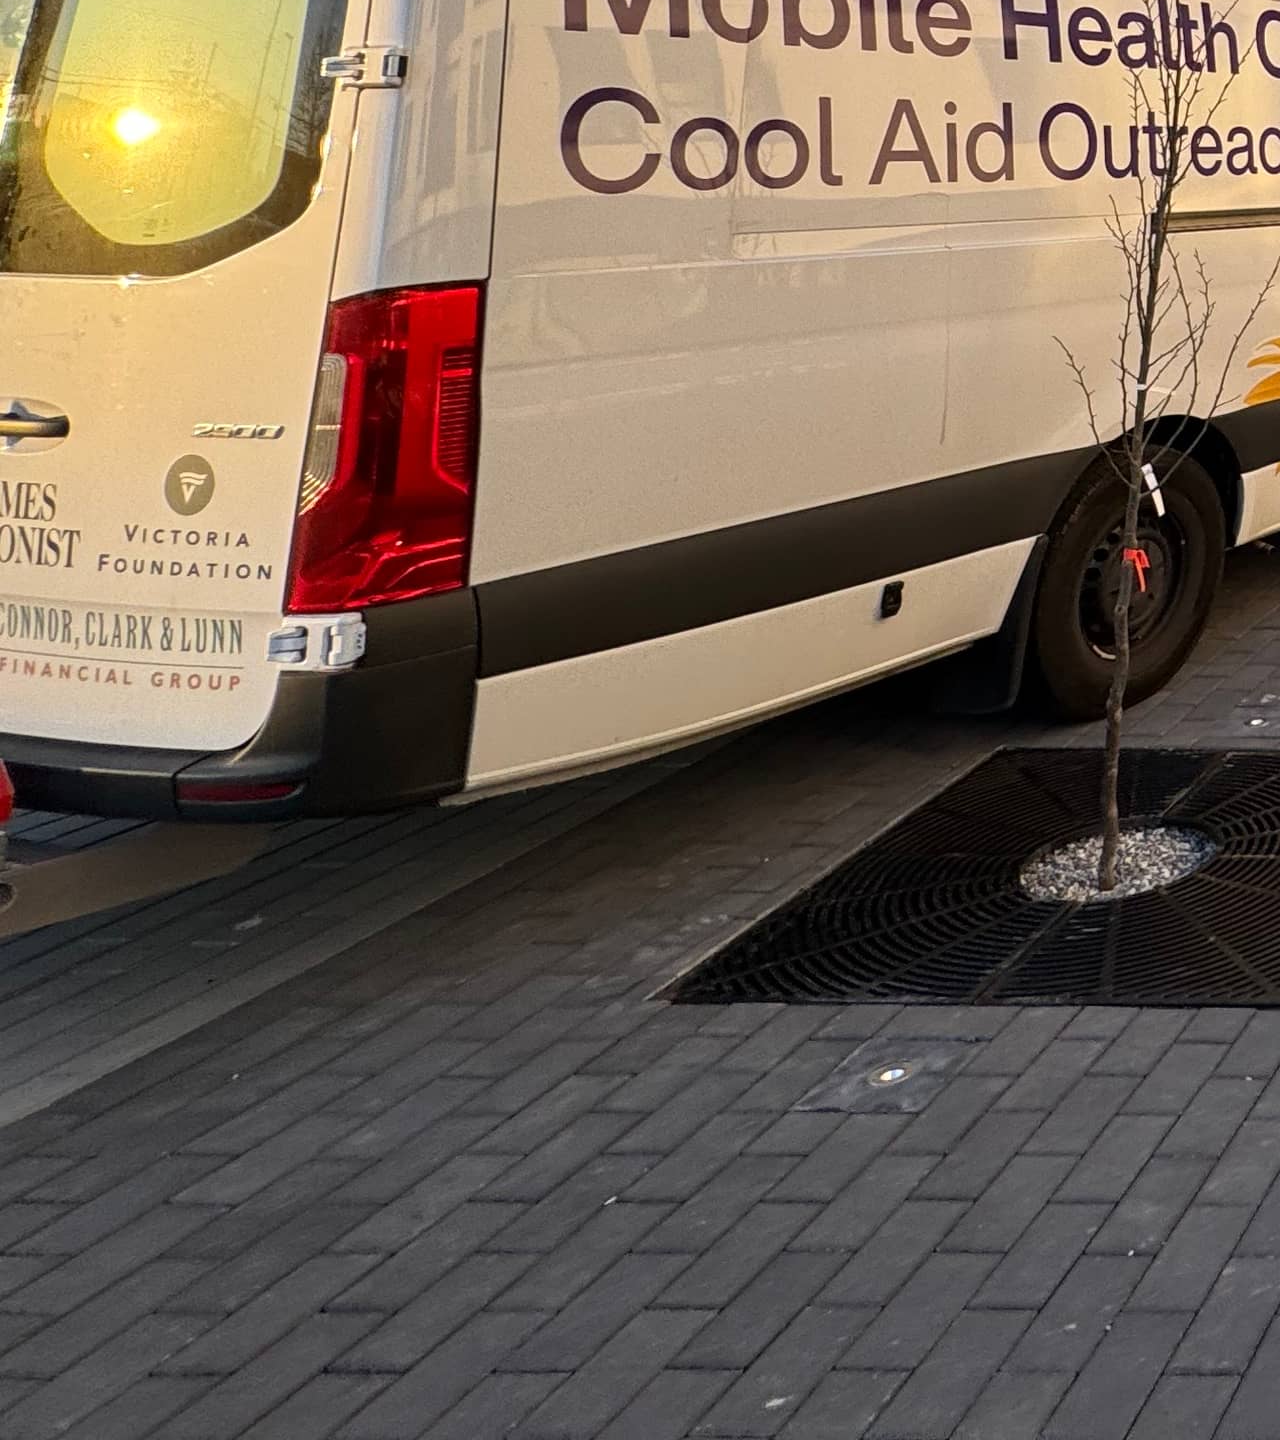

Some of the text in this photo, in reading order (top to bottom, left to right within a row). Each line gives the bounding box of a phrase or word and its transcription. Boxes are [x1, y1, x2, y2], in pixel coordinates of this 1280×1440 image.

[560, 85, 844, 195] Cool
[868, 98, 1015, 185] Aid
[191, 423, 285, 440] 2500
[0, 524, 81, 568] ONIST
[124, 524, 251, 548] VICTORIA
[98, 554, 272, 580] FOUNDATION
[85, 610, 152, 650] CLARK
[160, 616, 174, 652] &
[180, 616, 243, 655] LUNN
[151, 671, 241, 691] GROUP
